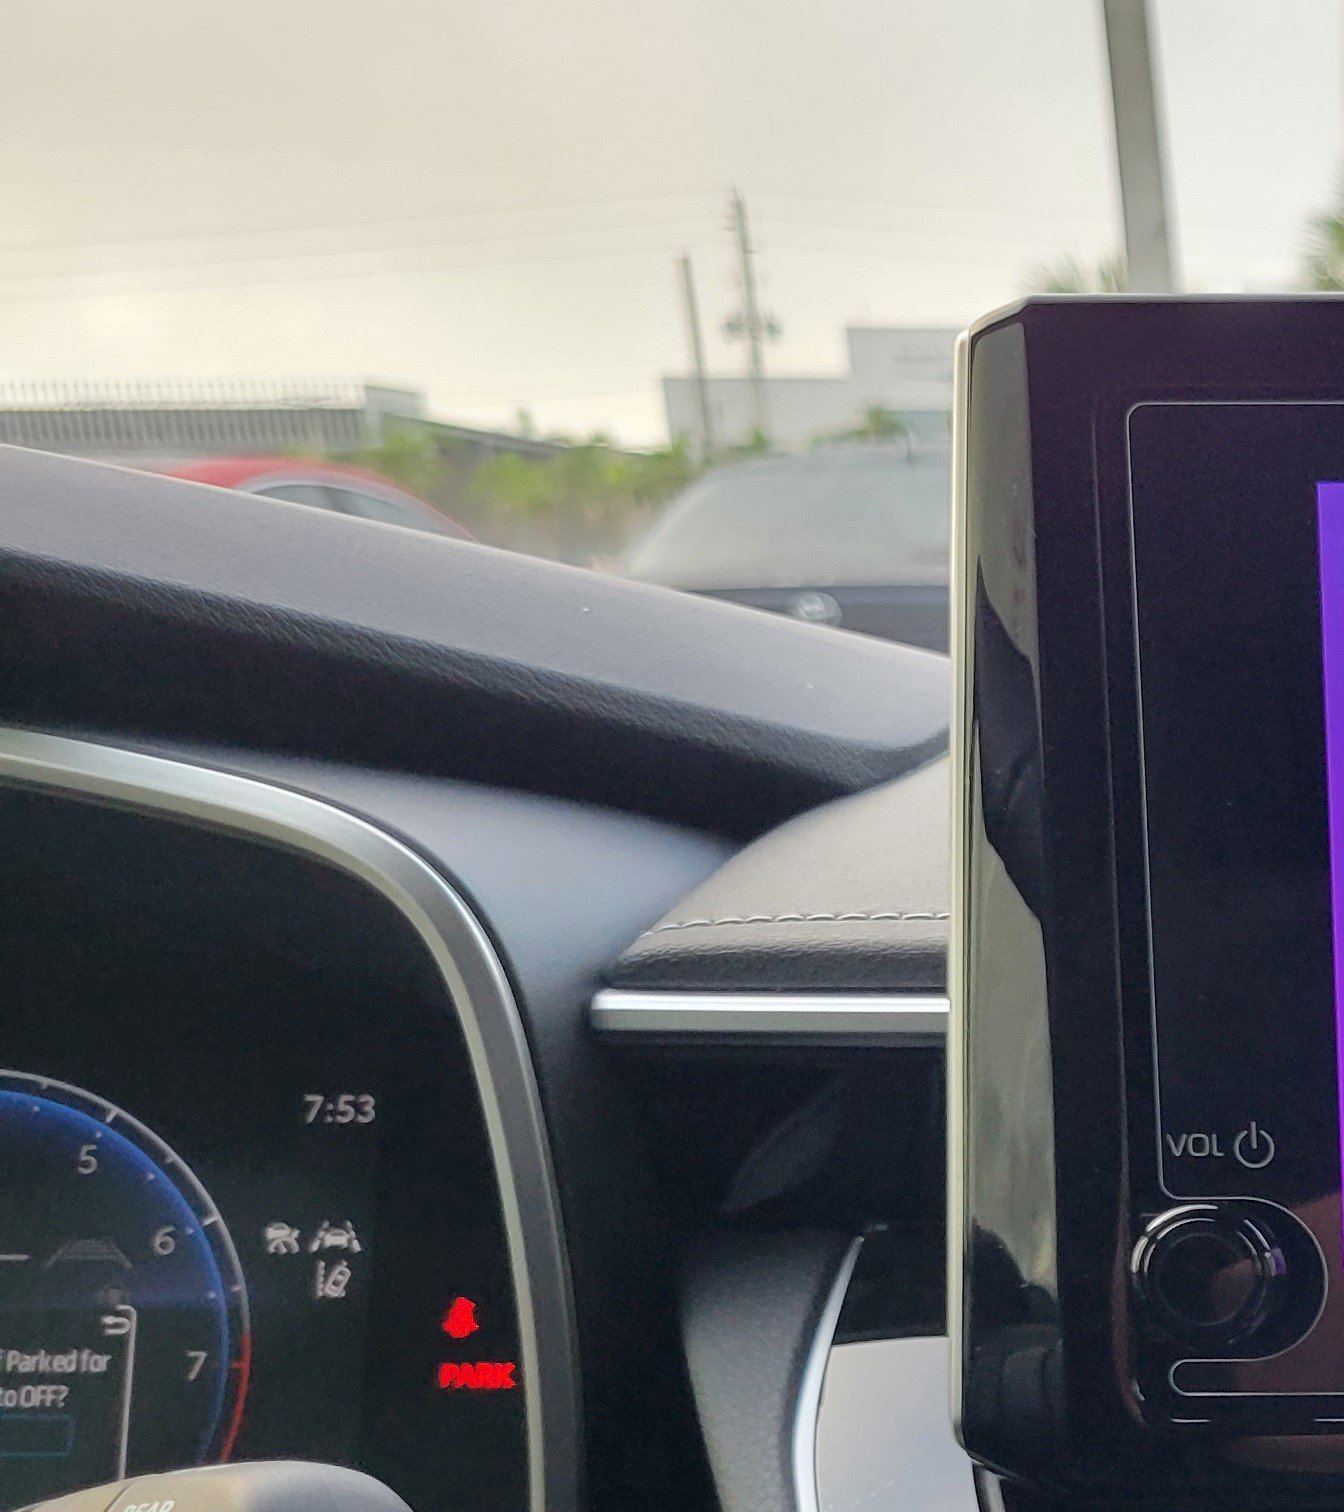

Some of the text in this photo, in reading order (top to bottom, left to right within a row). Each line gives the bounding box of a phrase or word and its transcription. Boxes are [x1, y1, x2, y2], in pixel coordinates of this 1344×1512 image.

[305, 1094, 376, 1123] 7:53
[1166, 1133, 1225, 1156] VOL
[78, 1145, 97, 1174] 5
[154, 1225, 176, 1256] 6
[6, 1349, 78, 1372] Parked
[80, 1348, 112, 1372] for
[186, 1350, 208, 1381] 7
[440, 1363, 516, 1389] PARK
[20, 1384, 70, 1408] OFF?
